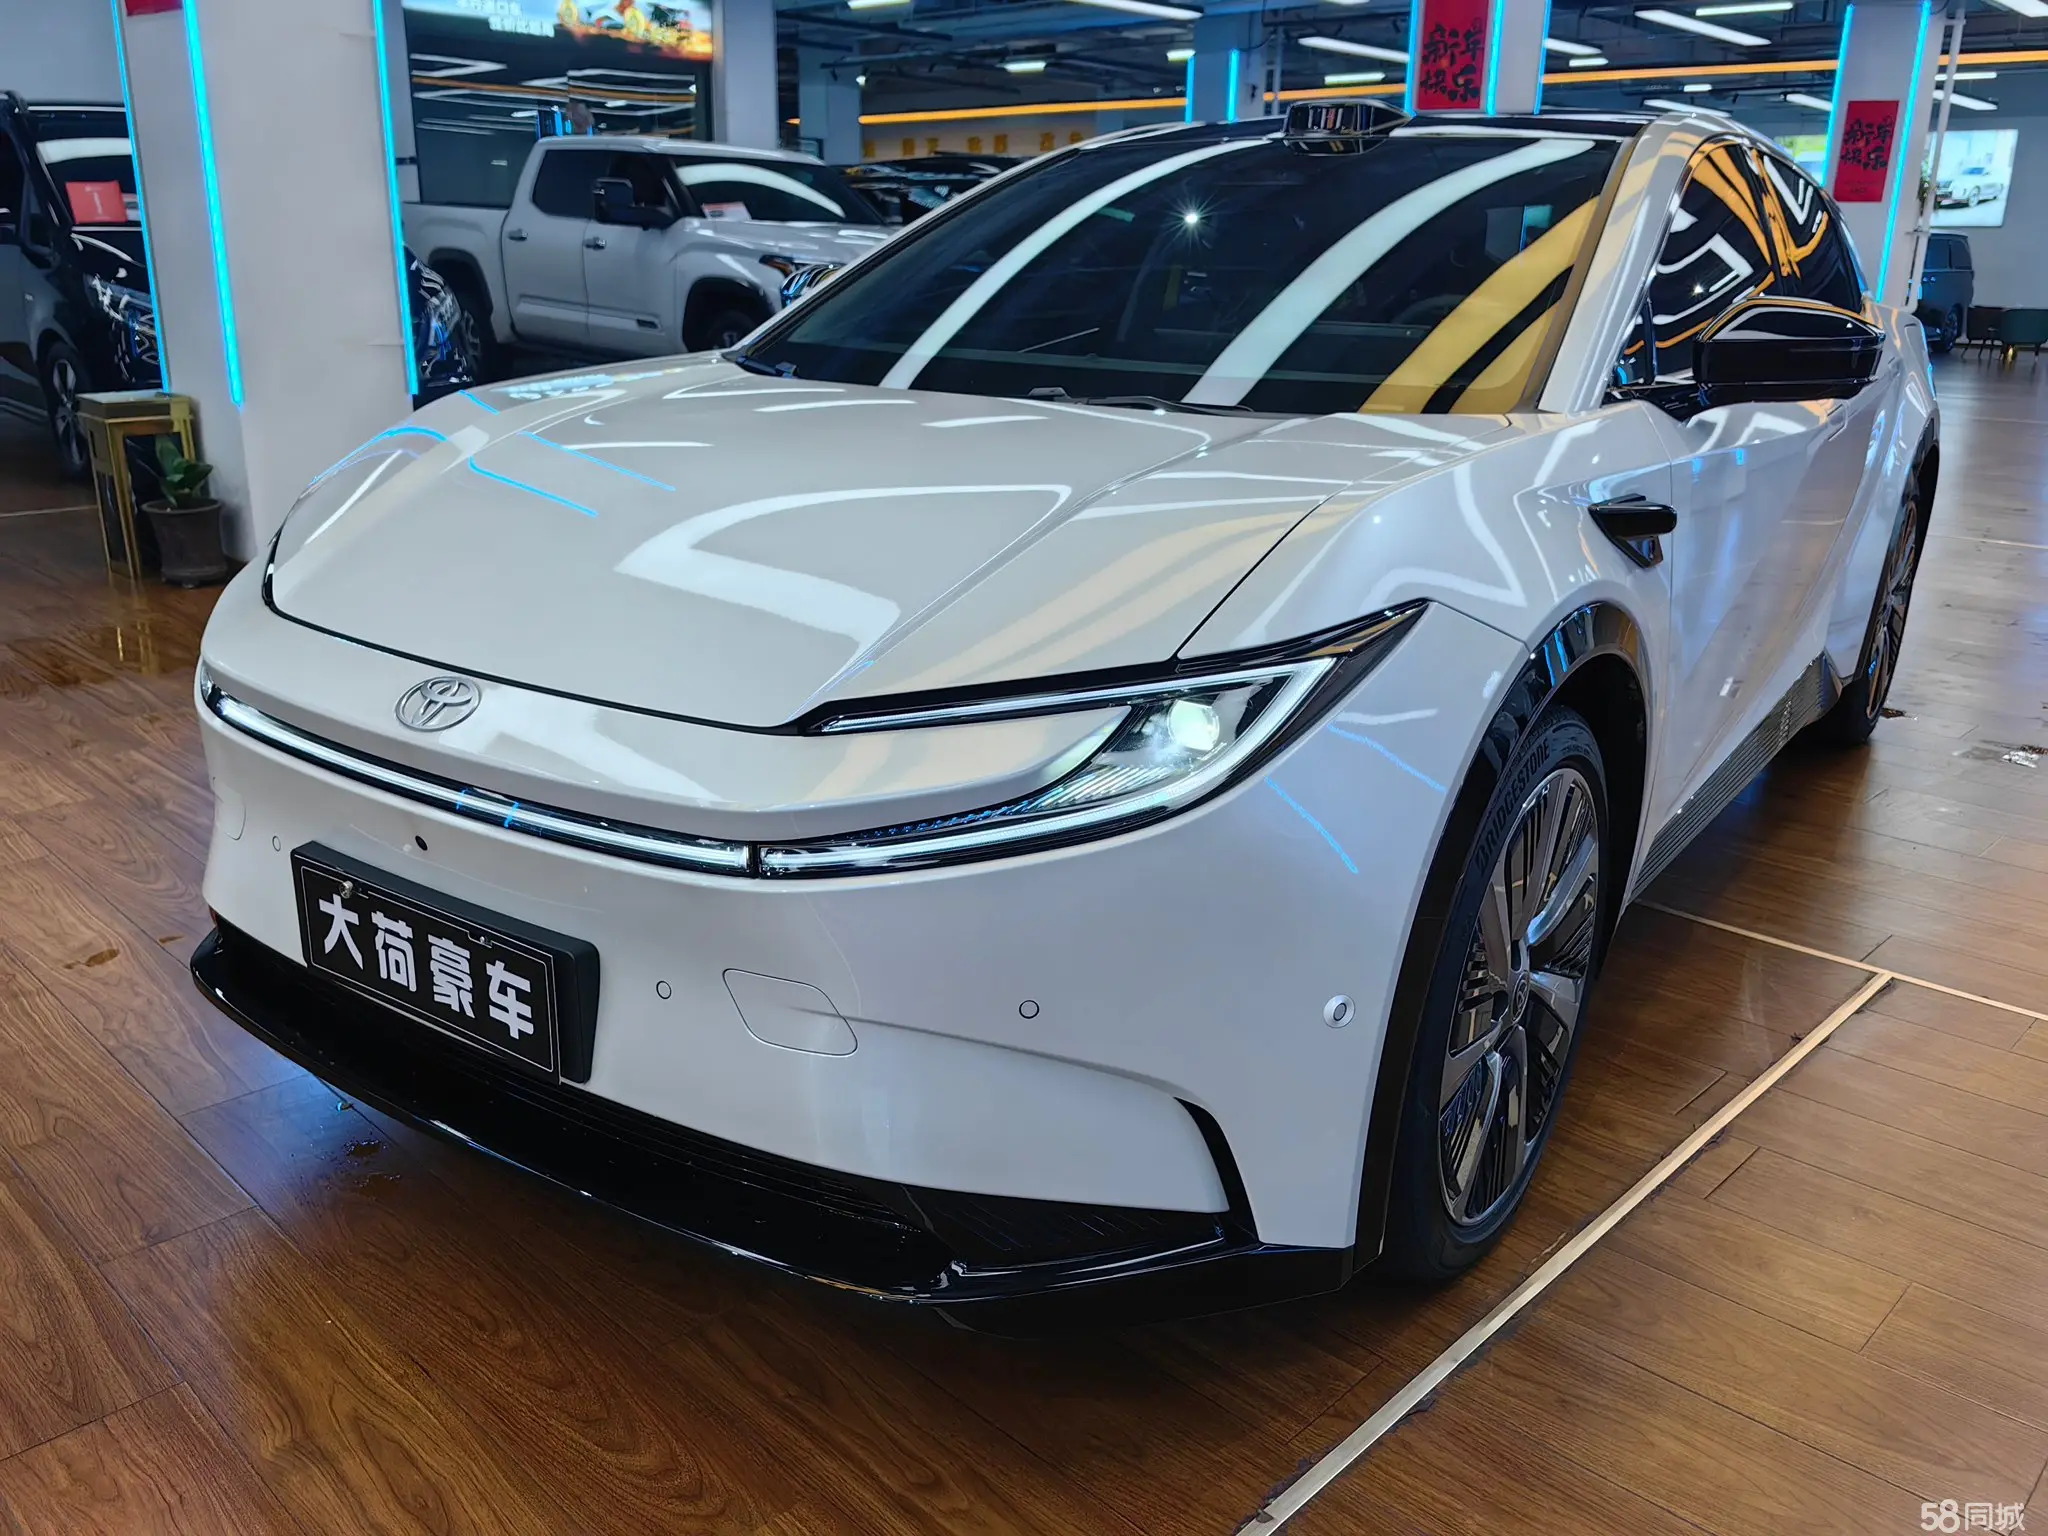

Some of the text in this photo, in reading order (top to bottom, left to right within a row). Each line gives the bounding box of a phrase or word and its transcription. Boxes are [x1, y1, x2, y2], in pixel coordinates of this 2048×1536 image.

[1422, 23, 1484, 66] 新年
[1420, 64, 1480, 104] 快乐
[1843, 118, 1892, 147] 新年
[1839, 146, 1888, 171] 快乐
[1475, 737, 1551, 876] BRIDGESTONE
[318, 894, 534, 1040] 大荷豪车
